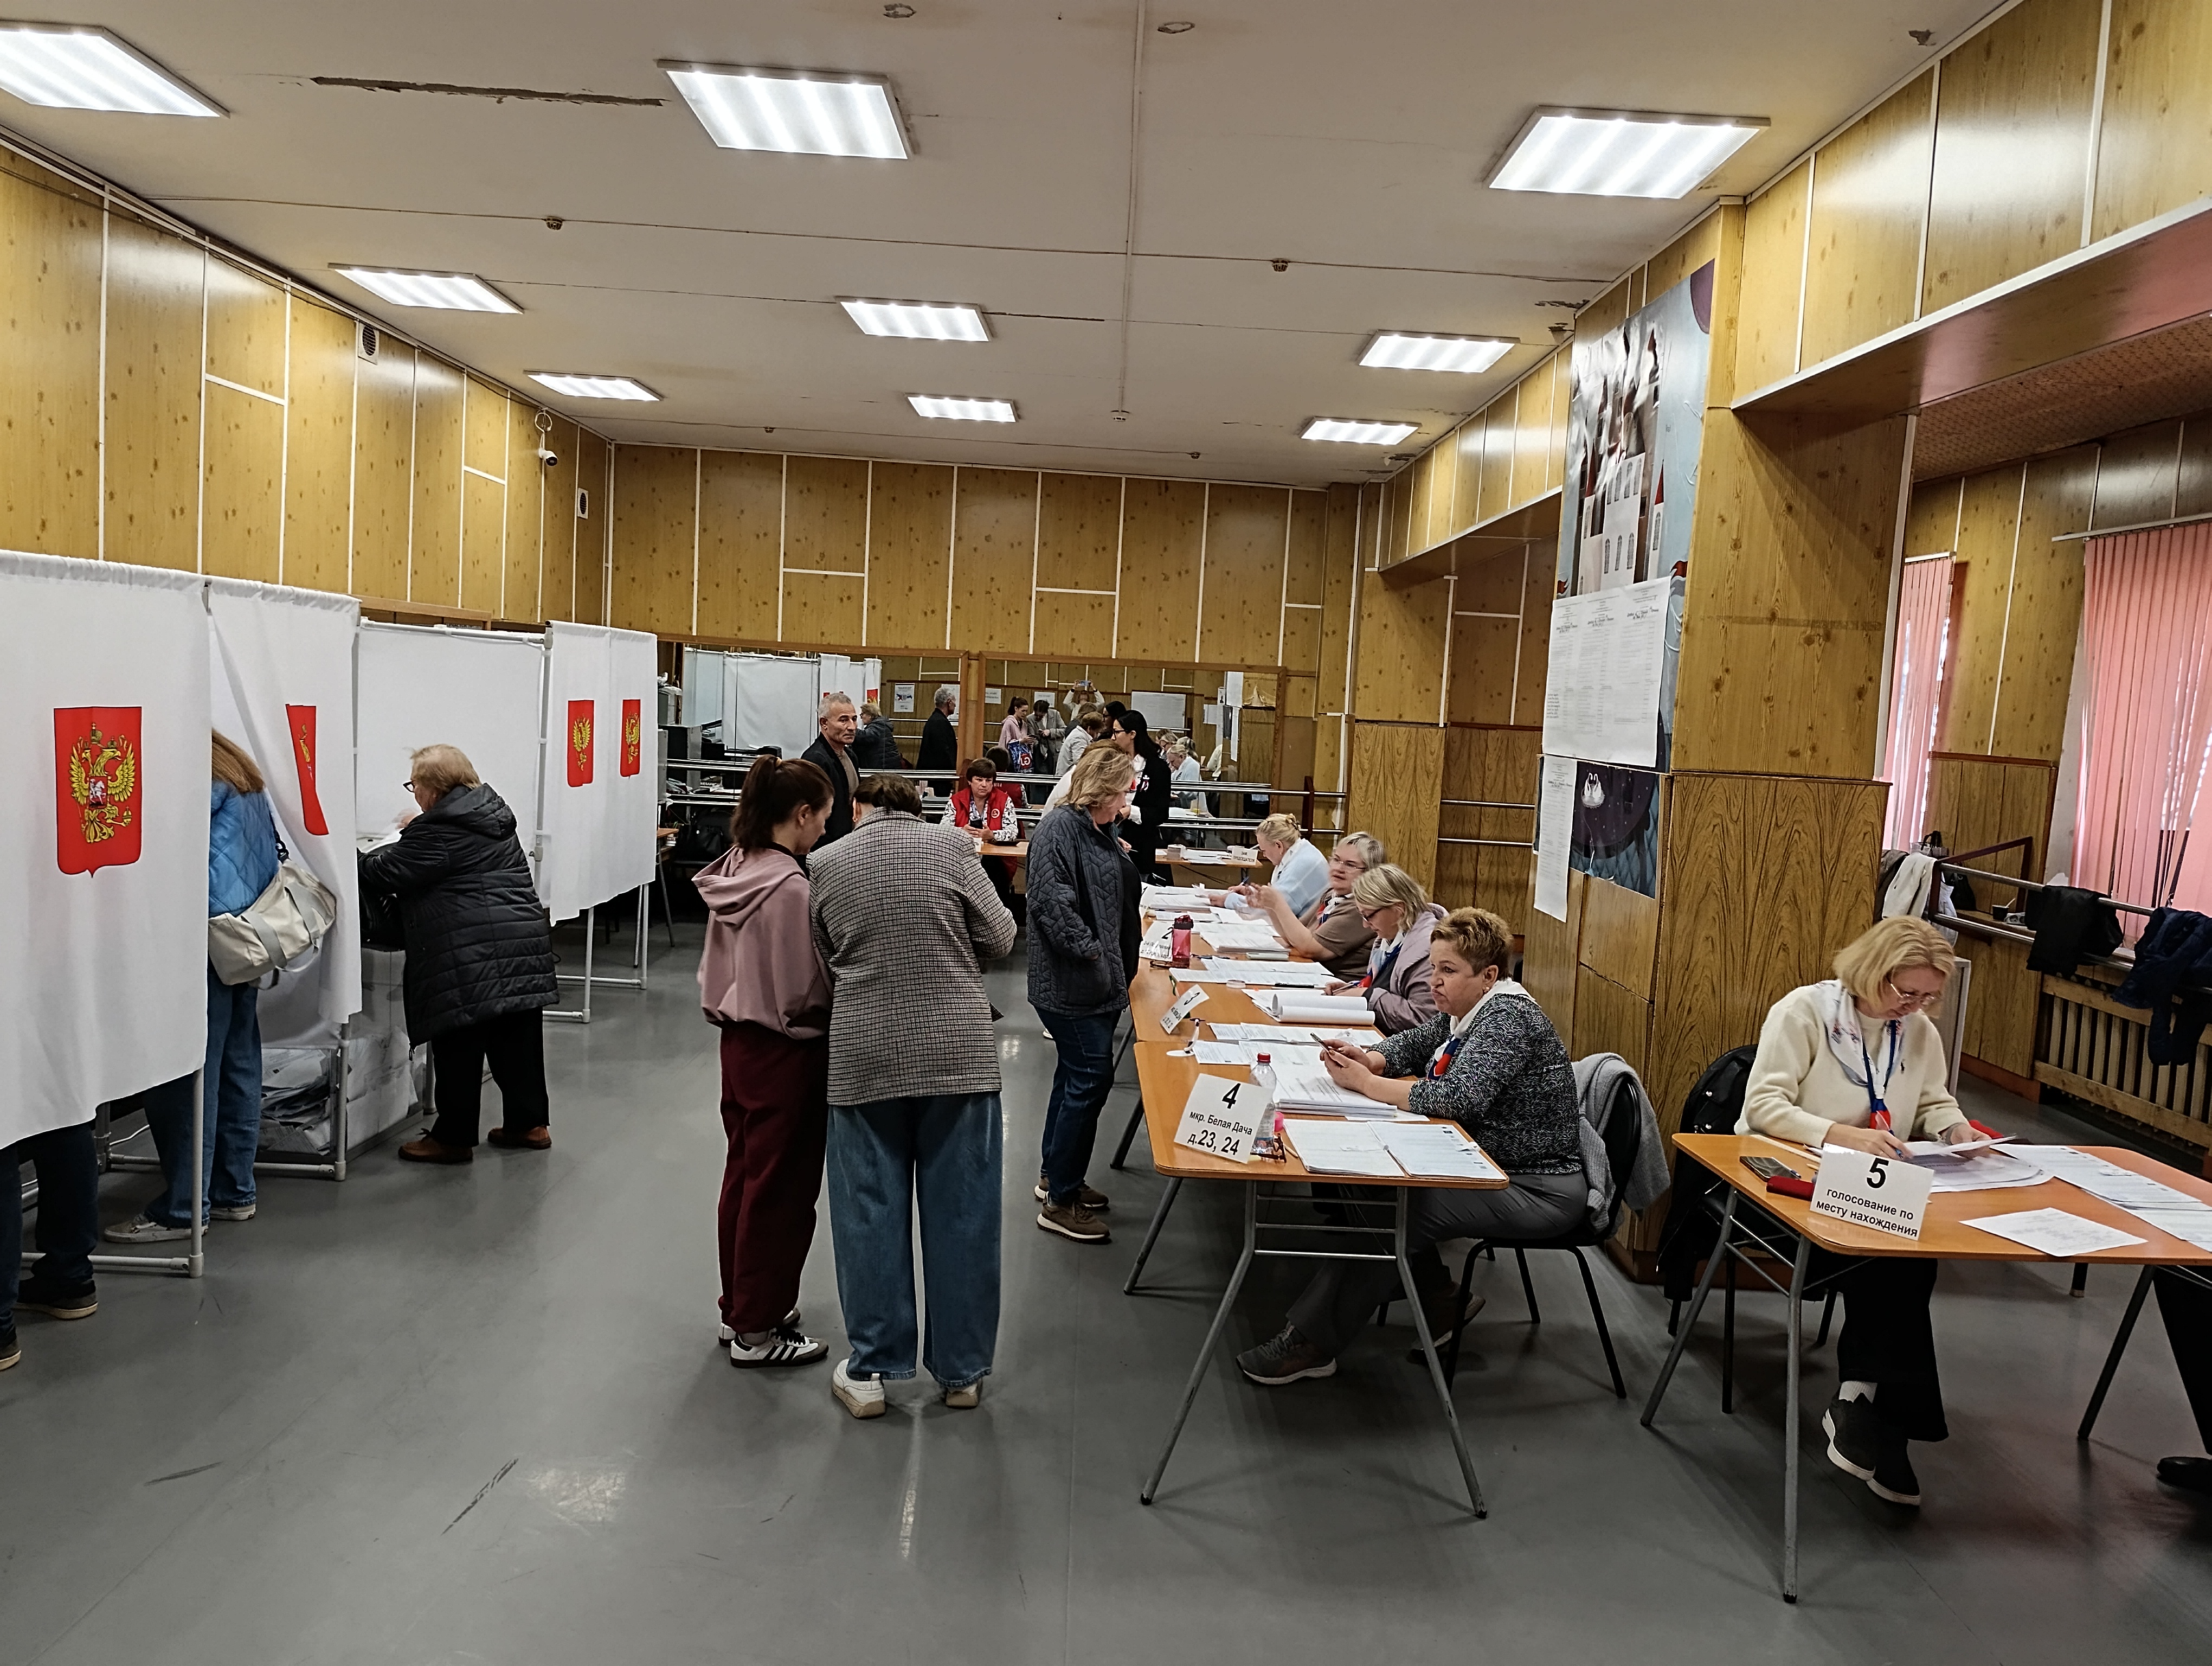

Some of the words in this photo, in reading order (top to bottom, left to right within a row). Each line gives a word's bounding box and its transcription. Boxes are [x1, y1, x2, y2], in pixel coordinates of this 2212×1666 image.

[1161, 926, 1174, 940] 2
[1184, 992, 1200, 1005] 3
[1222, 1083, 1241, 1109] 4
[1189, 1112, 1205, 1123] мкр.
[1207, 1114, 1231, 1129] Белая
[1231, 1122, 1252, 1135] Дача
[1187, 1130, 1217, 1152] д.23,
[1221, 1137, 1240, 1155] 24
[1867, 1157, 1889, 1189] 5
[1827, 1189, 1896, 1215] голосование
[1900, 1210, 1913, 1220] по
[1816, 1201, 1848, 1218] месту
[1850, 1211, 1918, 1237] нахождения
